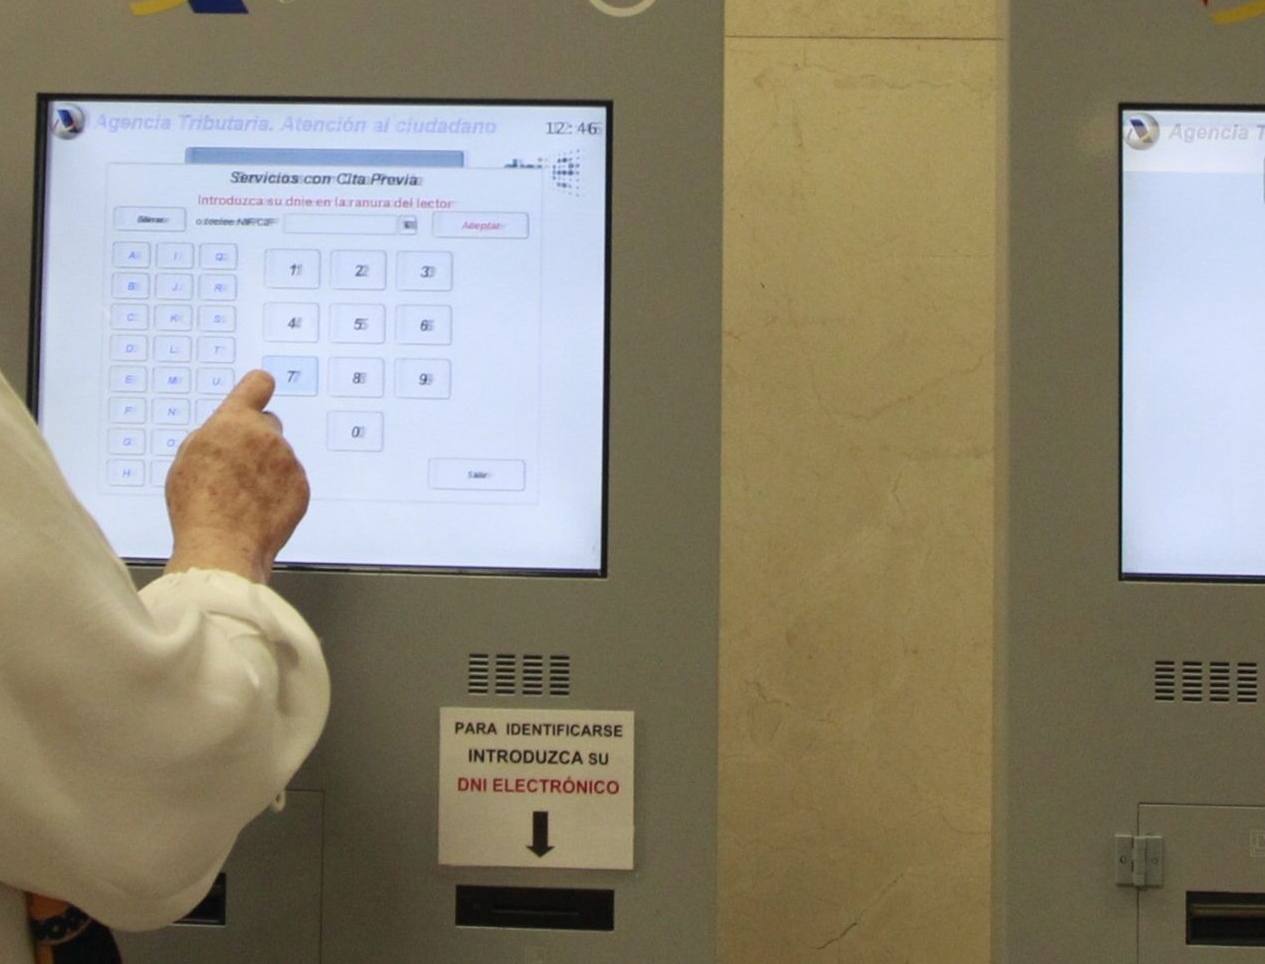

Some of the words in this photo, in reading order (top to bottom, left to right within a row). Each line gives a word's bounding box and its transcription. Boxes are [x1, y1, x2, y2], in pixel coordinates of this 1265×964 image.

[97, 115, 171, 133] Agencia
[178, 115, 273, 132] Tributaria.
[281, 115, 366, 133] Atención
[374, 117, 389, 133] al
[395, 117, 497, 135] ciudadano
[1168, 124, 1249, 143] Agencia
[230, 171, 300, 185] Servicios
[303, 173, 332, 185] con
[336, 172, 367, 186] Cita
[370, 172, 421, 186] Previa
[197, 194, 263, 206] Introduzca
[266, 197, 284, 206] su
[316, 198, 330, 207] en
[334, 196, 346, 207] la
[392, 196, 413, 208] del
[416, 197, 452, 209] lector
[455, 722, 497, 735] PARA
[506, 723, 623, 737] IDENTIFICARSE
[468, 749, 583, 765] INTRODUZCA
[588, 752, 609, 765] SU
[457, 777, 487, 792] DNI
[492, 776, 620, 795] ELECTRÓNICO
